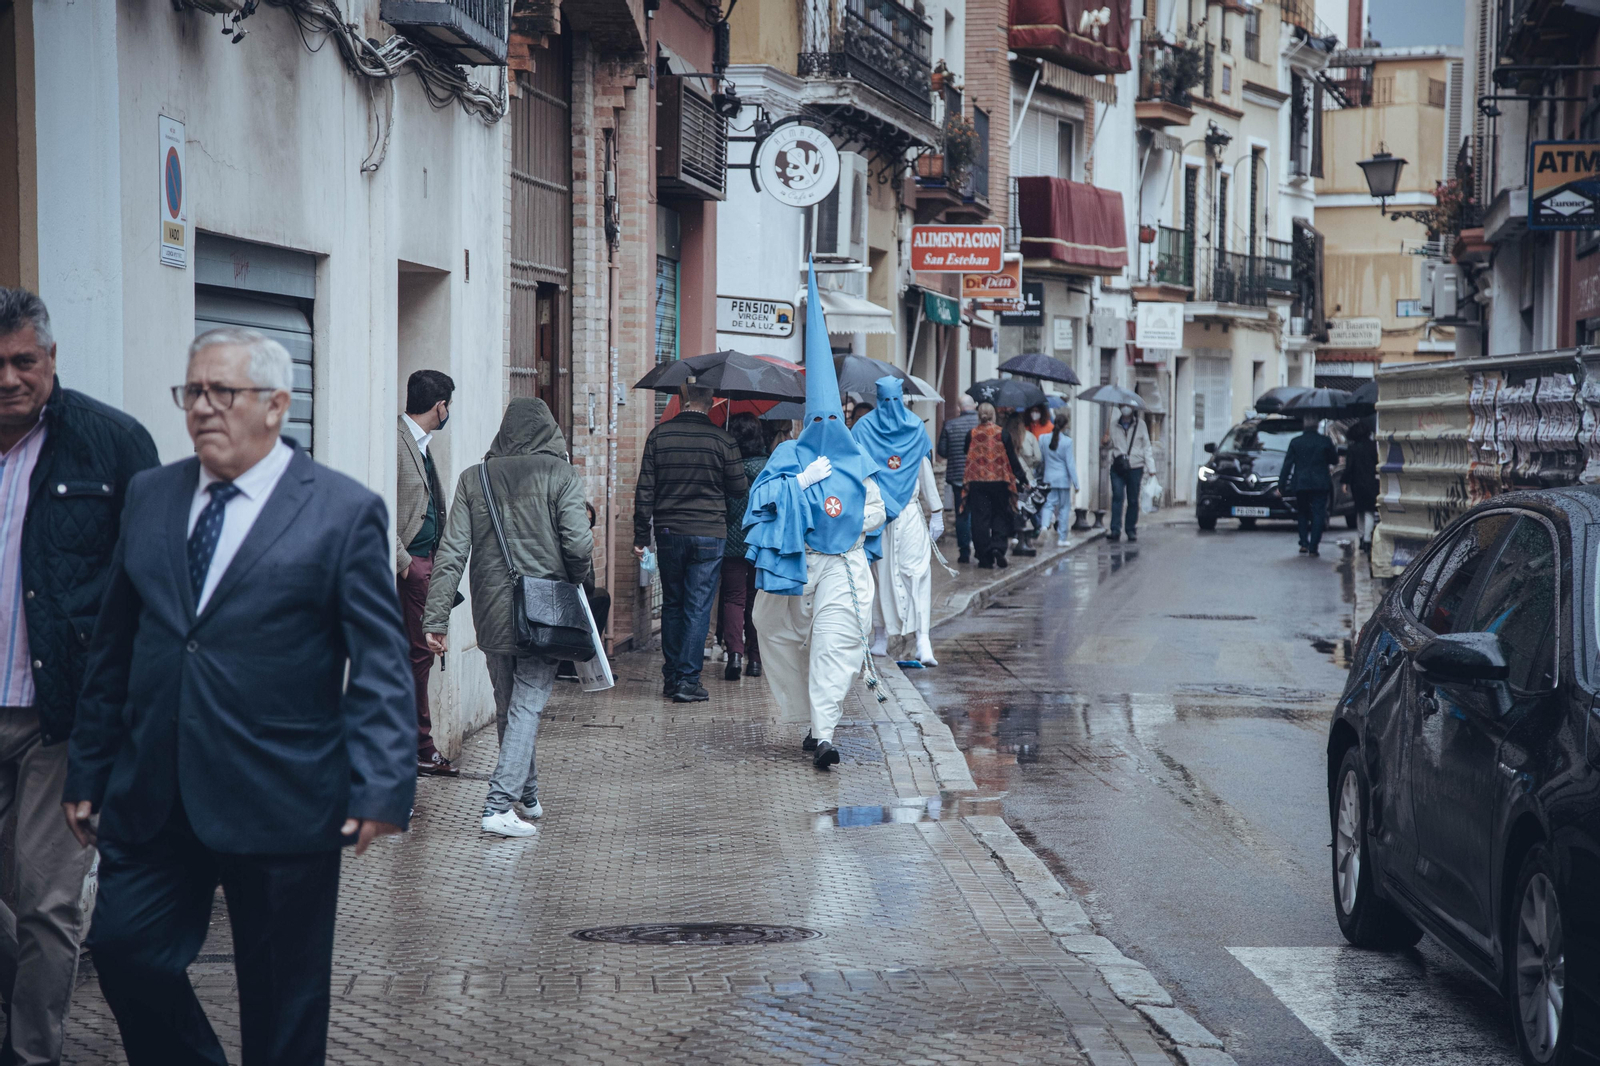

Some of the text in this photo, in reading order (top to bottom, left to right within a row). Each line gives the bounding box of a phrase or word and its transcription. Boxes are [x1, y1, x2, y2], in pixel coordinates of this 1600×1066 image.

[1537, 150, 1600, 174] ATM
[1550, 199, 1586, 208] Euronet
[168, 227, 180, 242] VADO
[913, 231, 1001, 249] ALIMENTACION
[923, 252, 990, 266] San Esteban
[731, 300, 777, 314] PENSION
[738, 312, 769, 321] VIRGEN
[745, 321, 756, 329] LA
[758, 322, 775, 330] LUZ
